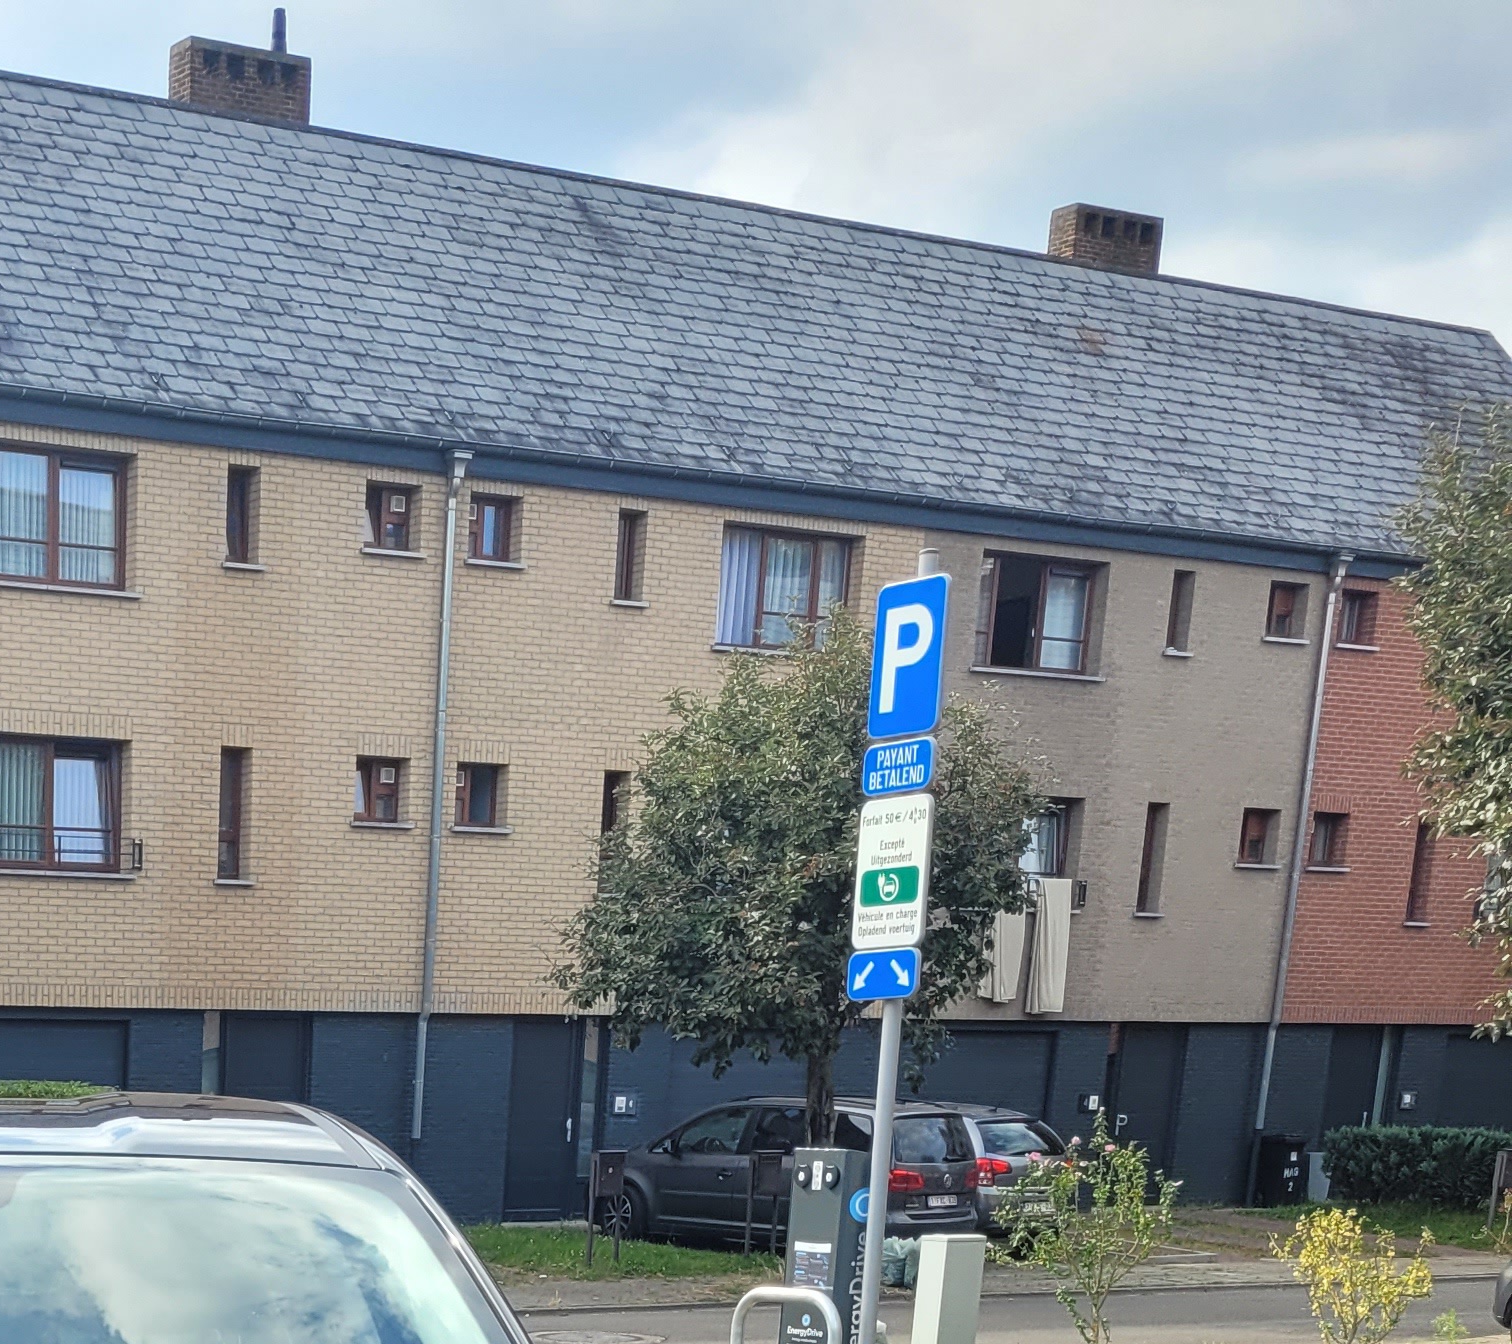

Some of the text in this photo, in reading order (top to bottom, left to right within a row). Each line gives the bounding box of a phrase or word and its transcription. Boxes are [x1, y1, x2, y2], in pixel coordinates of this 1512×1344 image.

[879, 604, 933, 714] P
[877, 744, 920, 770] PAYANT
[869, 764, 925, 790] BETALEND
[863, 814, 883, 828] Forfait
[879, 838, 905, 852] Excepté
[871, 851, 912, 867] Uitgezonderd
[858, 908, 918, 923] Véhicule en charge
[858, 923, 915, 939] Opladend voertuig
[786, 1325, 824, 1338] EnergyDrive
